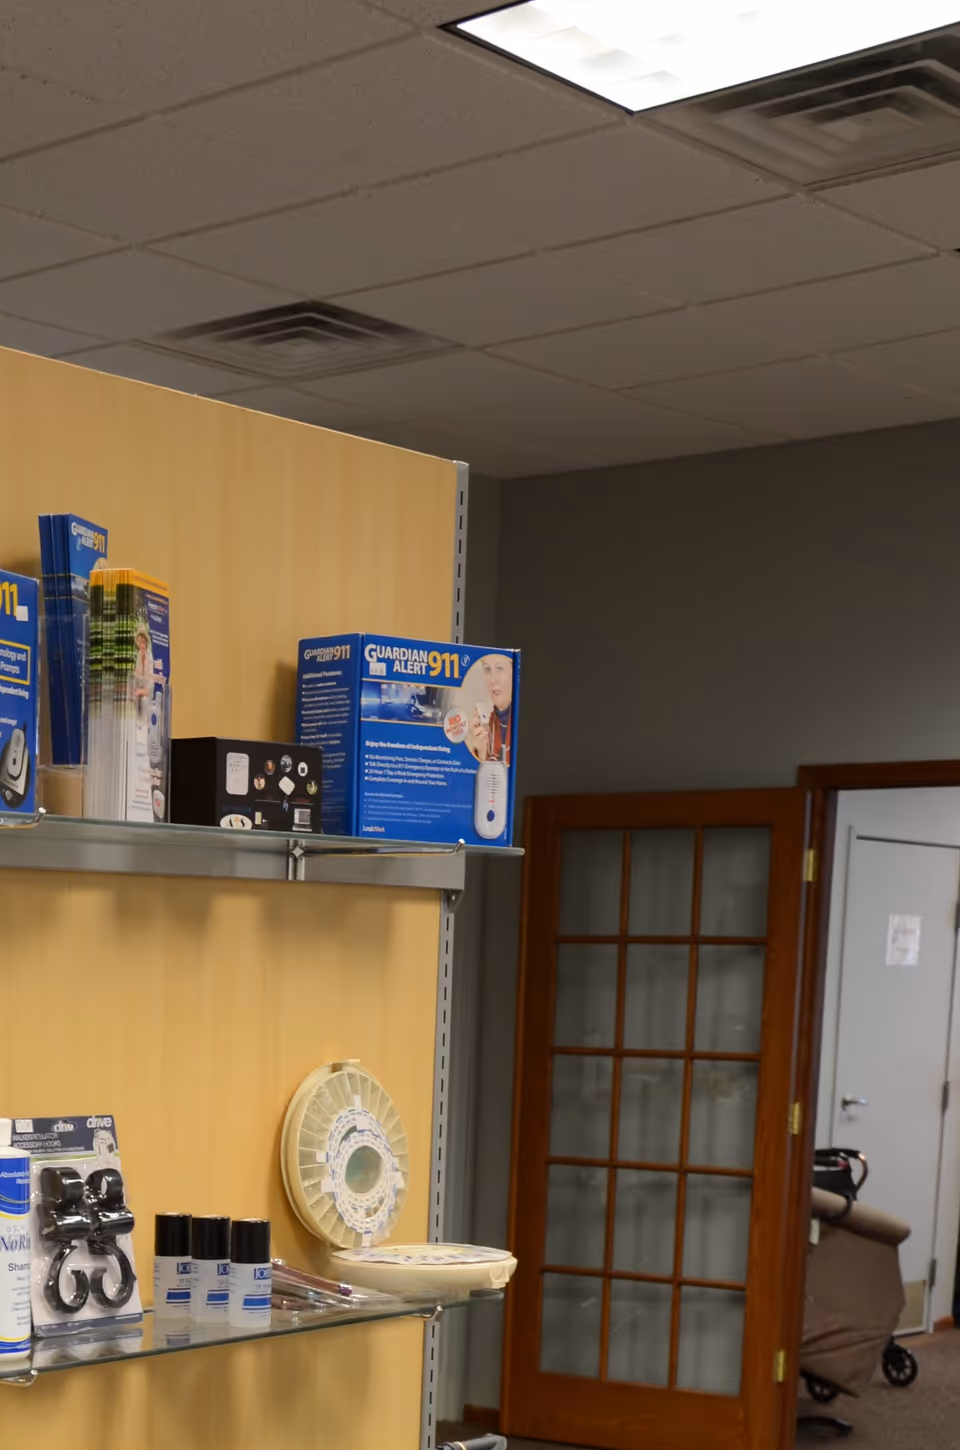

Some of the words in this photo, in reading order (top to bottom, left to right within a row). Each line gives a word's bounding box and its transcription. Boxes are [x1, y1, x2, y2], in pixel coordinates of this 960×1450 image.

[304, 646, 333, 660] GUARDIAN
[316, 653, 333, 662] ALERT
[333, 645, 350, 660] 911
[364, 643, 428, 663] GUARDIAN
[393, 660, 428, 675] ALERT
[428, 651, 460, 679] 911
[86, 1115, 112, 1128] drive
